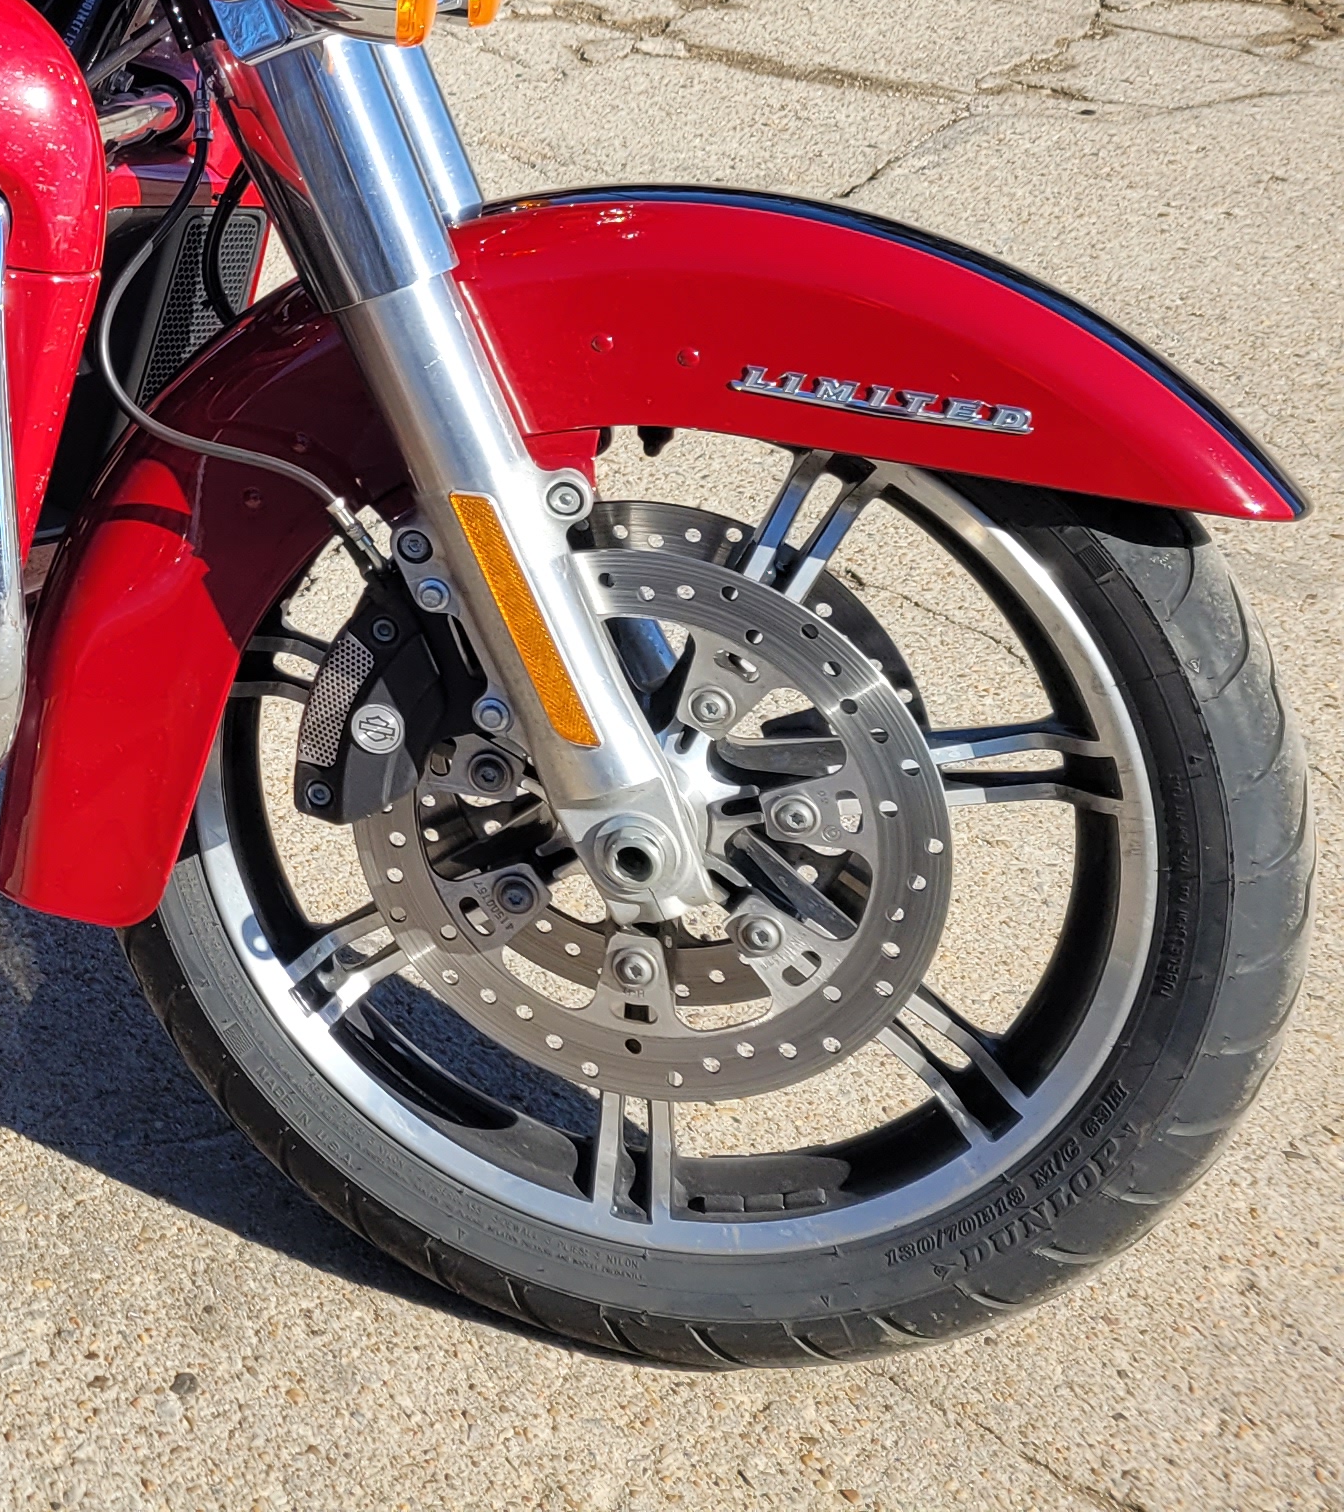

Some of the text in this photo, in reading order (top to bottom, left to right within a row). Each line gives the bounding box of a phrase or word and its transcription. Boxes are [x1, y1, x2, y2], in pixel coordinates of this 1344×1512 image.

[739, 364, 1034, 432] LIMITED
[254, 1065, 296, 1109] MADE
[293, 1108, 314, 1128] IN
[960, 1137, 1123, 1272] DUNLOP
